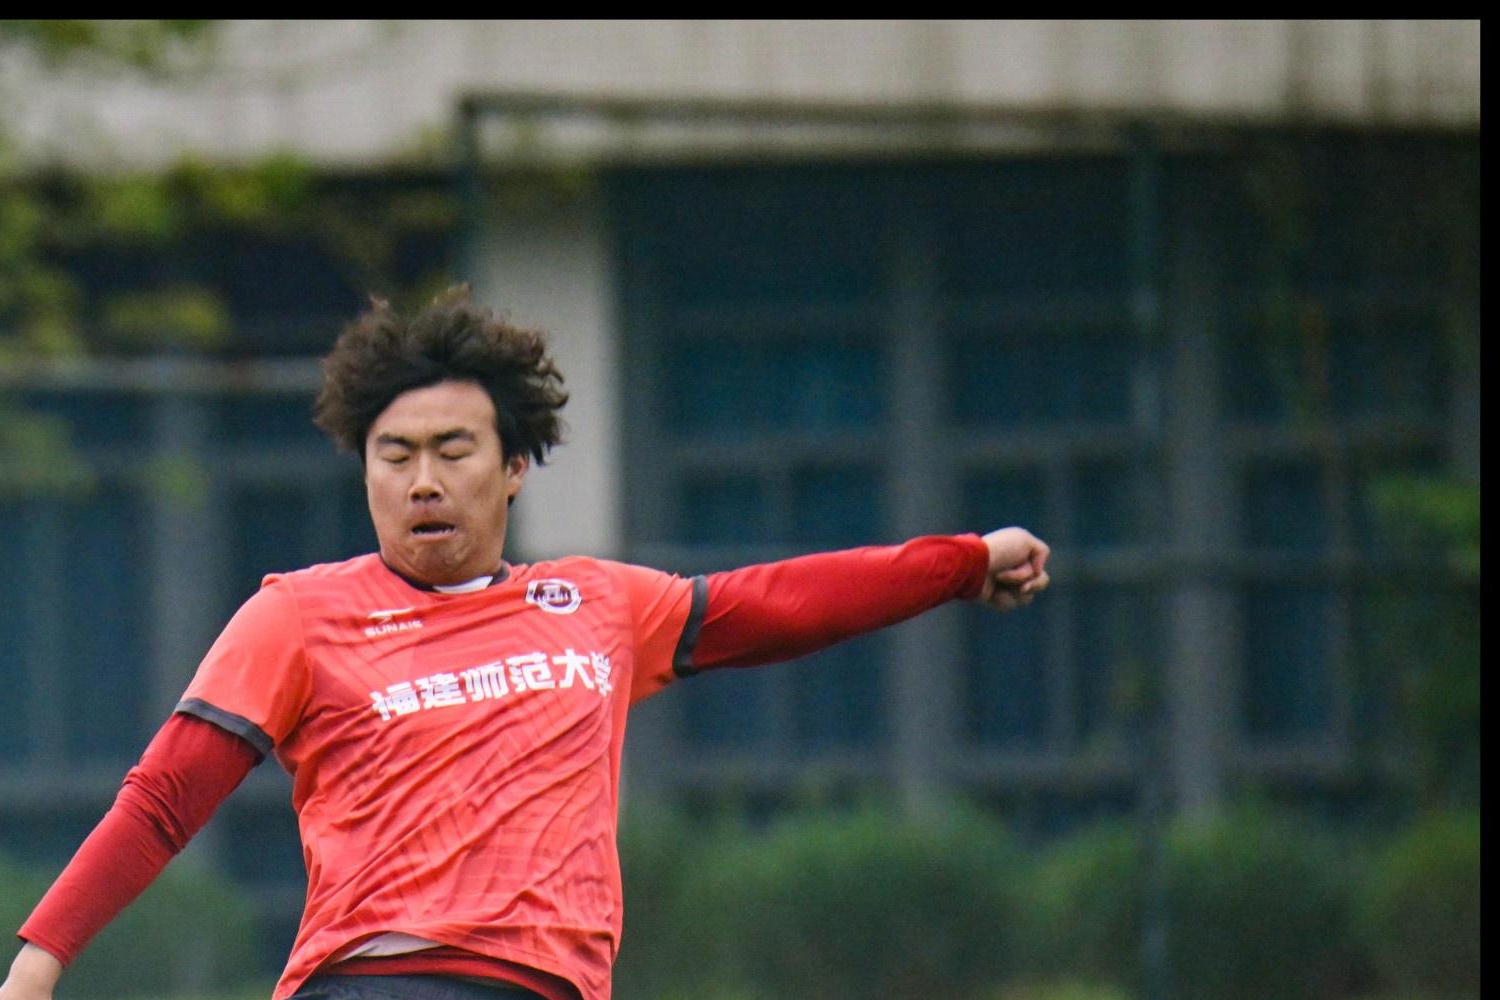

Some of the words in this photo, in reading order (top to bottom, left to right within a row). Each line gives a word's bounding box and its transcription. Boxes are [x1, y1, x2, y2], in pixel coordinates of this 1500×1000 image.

[370, 648, 612, 721] 福建师范大学
